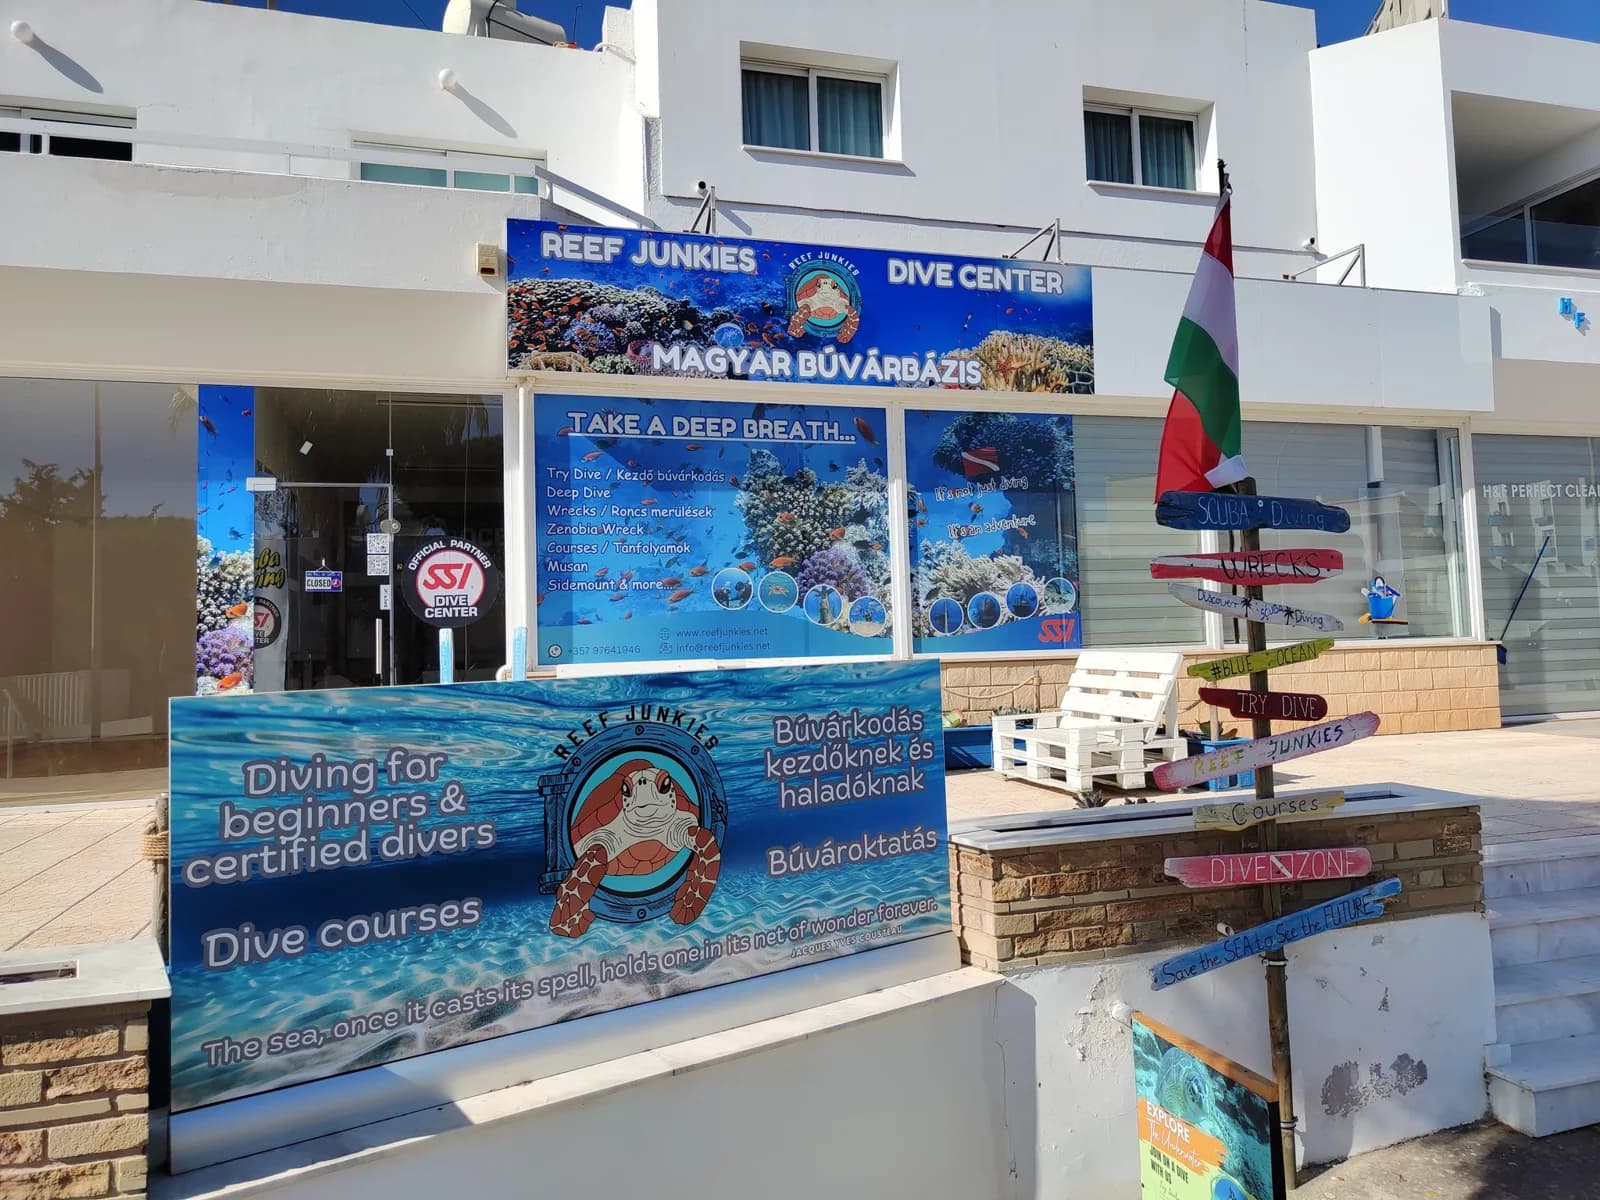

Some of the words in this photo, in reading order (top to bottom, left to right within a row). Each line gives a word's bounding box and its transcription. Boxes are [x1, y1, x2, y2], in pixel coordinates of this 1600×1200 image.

[542, 232, 623, 262] REEF
[632, 239, 758, 274] JUNKIES
[788, 252, 813, 270] REEF
[817, 251, 861, 276] JUNKIES
[889, 259, 952, 287] DIVE
[958, 263, 1064, 295] CENTER
[652, 345, 792, 377] MAGYAR
[799, 344, 982, 385] BÚVÁRBÁZIS
[567, 412, 641, 435] TAKE
[647, 417, 667, 436] A
[673, 417, 737, 438] DEEP
[743, 419, 856, 441] BREATH...
[547, 467, 569, 482] Try
[574, 467, 601, 481] Dive
[604, 468, 612, 481] /
[616, 468, 654, 481] Kezdő
[657, 470, 725, 483] búvárkodás
[934, 486, 954, 501] It's
[954, 484, 974, 498] not
[976, 479, 997, 498] just
[1000, 475, 1029, 491] diving
[547, 486, 579, 501] Deep
[584, 486, 611, 499] Dive
[1483, 484, 1507, 498] H&F
[1511, 484, 1562, 498] PERFECT
[547, 504, 596, 517] Wrecks
[600, 505, 608, 518] /
[611, 505, 647, 518] Roncs
[651, 504, 713, 518] merülések
[1198, 496, 1250, 525] SCUBA
[1272, 501, 1325, 529] Diving
[547, 523, 598, 536] Zenobia
[603, 523, 644, 536] Wreck
[948, 523, 967, 538] It's
[968, 523, 983, 535] an
[984, 514, 1036, 532] adventure
[408, 540, 447, 571] OFFICIAL
[450, 539, 492, 569] PARTNER
[546, 541, 598, 554] Courses
[602, 542, 609, 554] /
[613, 541, 690, 555] Tanfolyamok
[423, 563, 472, 590] SSI
[547, 560, 588, 572] Musan
[1220, 552, 1321, 580] WRECKS
[307, 578, 331, 588] CLOSED
[547, 578, 615, 592] Sidemount
[619, 579, 629, 590] &
[632, 579, 674, 591] more...
[425, 607, 478, 618] CENTER
[435, 596, 468, 607] DIVE
[1197, 588, 1240, 608] Discover
[1295, 609, 1324, 629] Diving
[676, 626, 769, 639] www.reefjunkies.net
[1038, 619, 1076, 643] SSI
[676, 642, 771, 654] info@reefjunkies.net
[1210, 655, 1253, 680] #BLUE
[1276, 643, 1318, 667] OCEAN
[1237, 692, 1267, 715] TRY
[1282, 695, 1319, 719] DIVE
[553, 711, 608, 760] REEF
[625, 704, 720, 751] JUNKIES
[776, 708, 923, 744] Búvárkodás
[766, 739, 902, 778] kezdőknek
[909, 738, 933, 761] és
[1192, 749, 1245, 777] REEF
[1267, 725, 1344, 758] JUNKIES
[246, 757, 375, 795] Diving
[388, 750, 444, 782] for
[781, 767, 925, 809] haladóknak
[223, 794, 427, 840] beginners
[440, 784, 466, 813] &
[1232, 798, 1319, 826] Courses
[186, 829, 368, 884] certified
[382, 823, 494, 858] divers
[769, 826, 937, 876] Búvároktatás
[1211, 855, 1267, 884] DIVE
[206, 926, 305, 968] Dive
[320, 900, 481, 947] courses
[790, 941, 832, 958] JACQUES
[834, 935, 858, 951] YVES
[859, 926, 904, 942] COUSTEAU
[1162, 962, 1198, 986] Save
[1199, 951, 1222, 971] the
[1223, 935, 1250, 963] SEA
[1254, 934, 1274, 950] to
[1275, 923, 1298, 944] See
[1300, 916, 1321, 937] the
[1323, 893, 1373, 925] FUTURE
[204, 1036, 259, 1067] The
[268, 1024, 324, 1053] sea,
[334, 1009, 398, 1037] once
[405, 999, 425, 1024] it
[432, 988, 497, 1017] casts
[503, 979, 532, 1002] its
[538, 963, 595, 998] spell,
[600, 951, 657, 982] holds
[664, 945, 700, 969] one
[703, 937, 722, 960] in
[726, 931, 750, 955] its
[754, 928, 785, 949] net
[789, 919, 808, 941] of
[811, 908, 875, 936] wonder
[878, 898, 938, 922] forever.
[1146, 1100, 1191, 1145] EXPLORE
